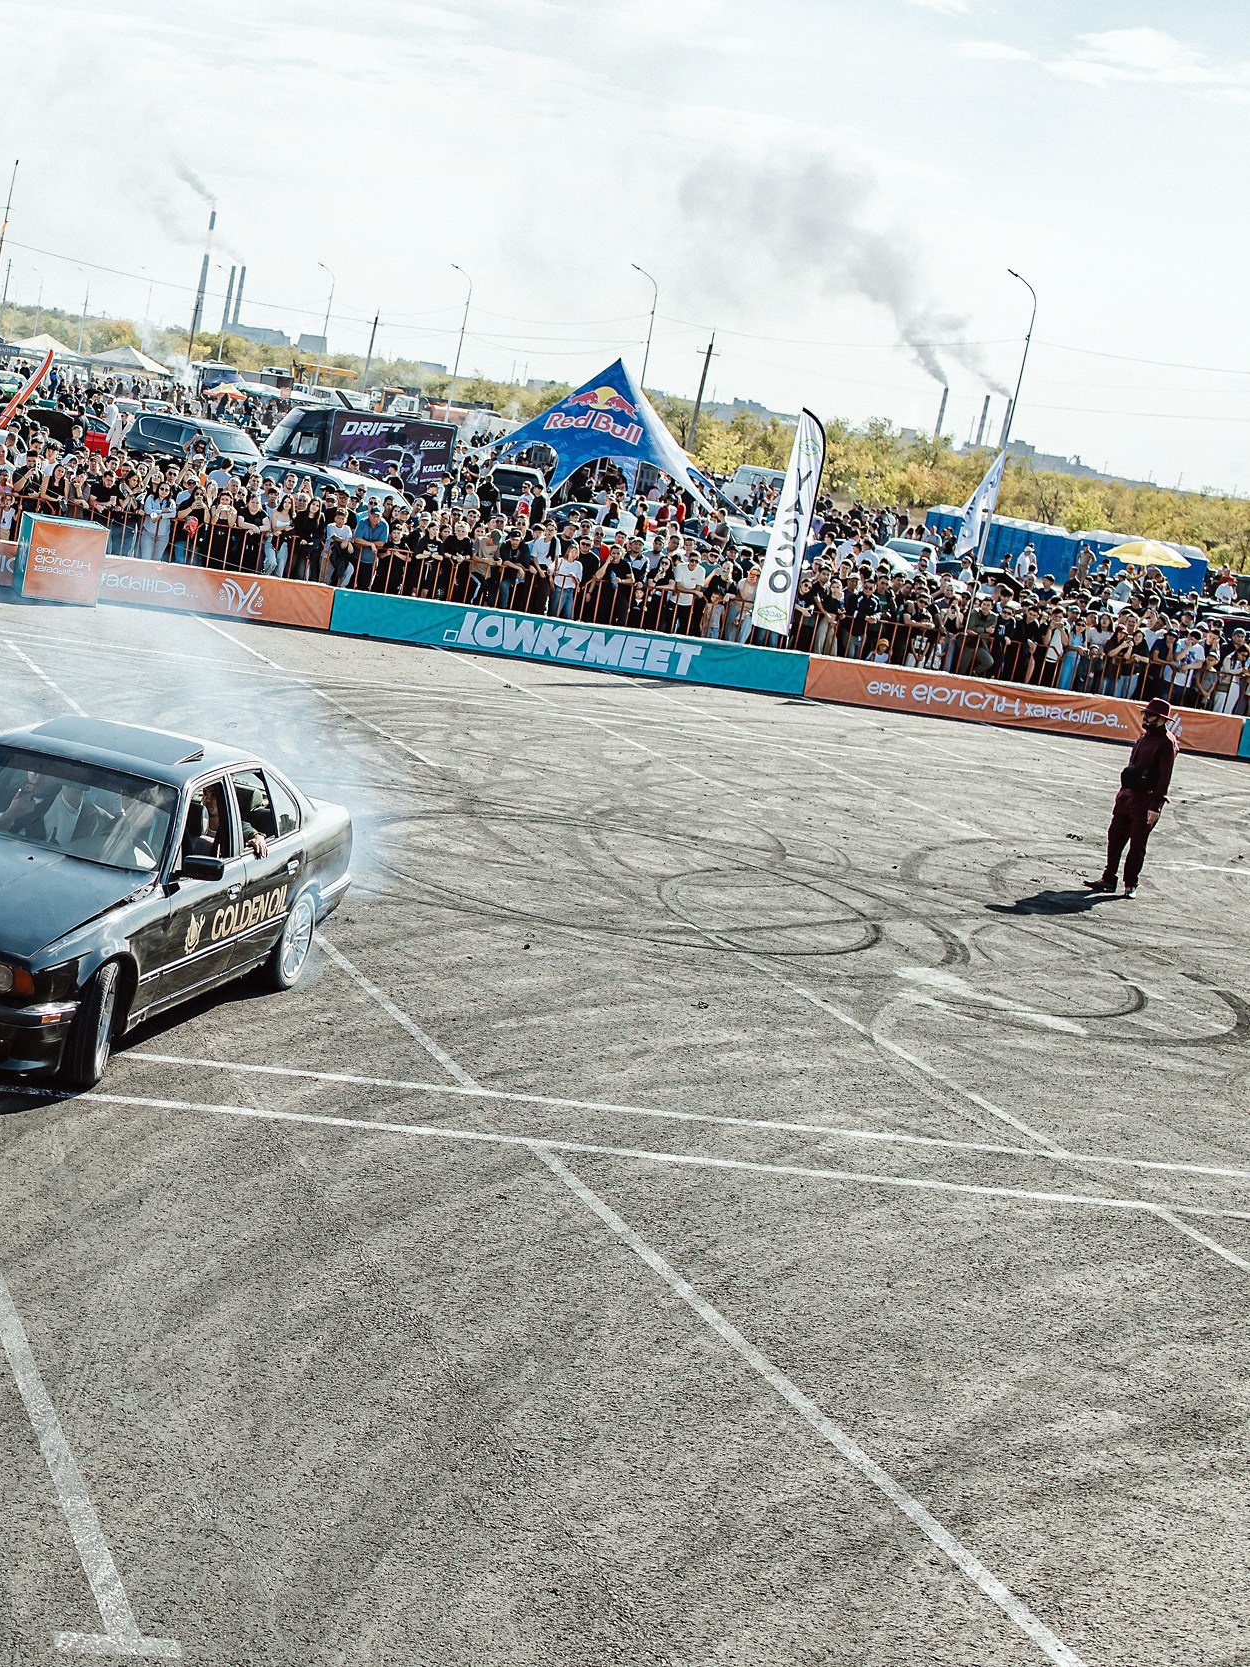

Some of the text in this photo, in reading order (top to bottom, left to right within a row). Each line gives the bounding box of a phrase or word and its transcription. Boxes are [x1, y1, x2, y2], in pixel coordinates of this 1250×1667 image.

[340, 421, 406, 436] DRIFT
[543, 410, 644, 446] Red Bull
[450, 611, 703, 676] LOWKZMEET
[211, 884, 288, 941] GOLDEN OIL
